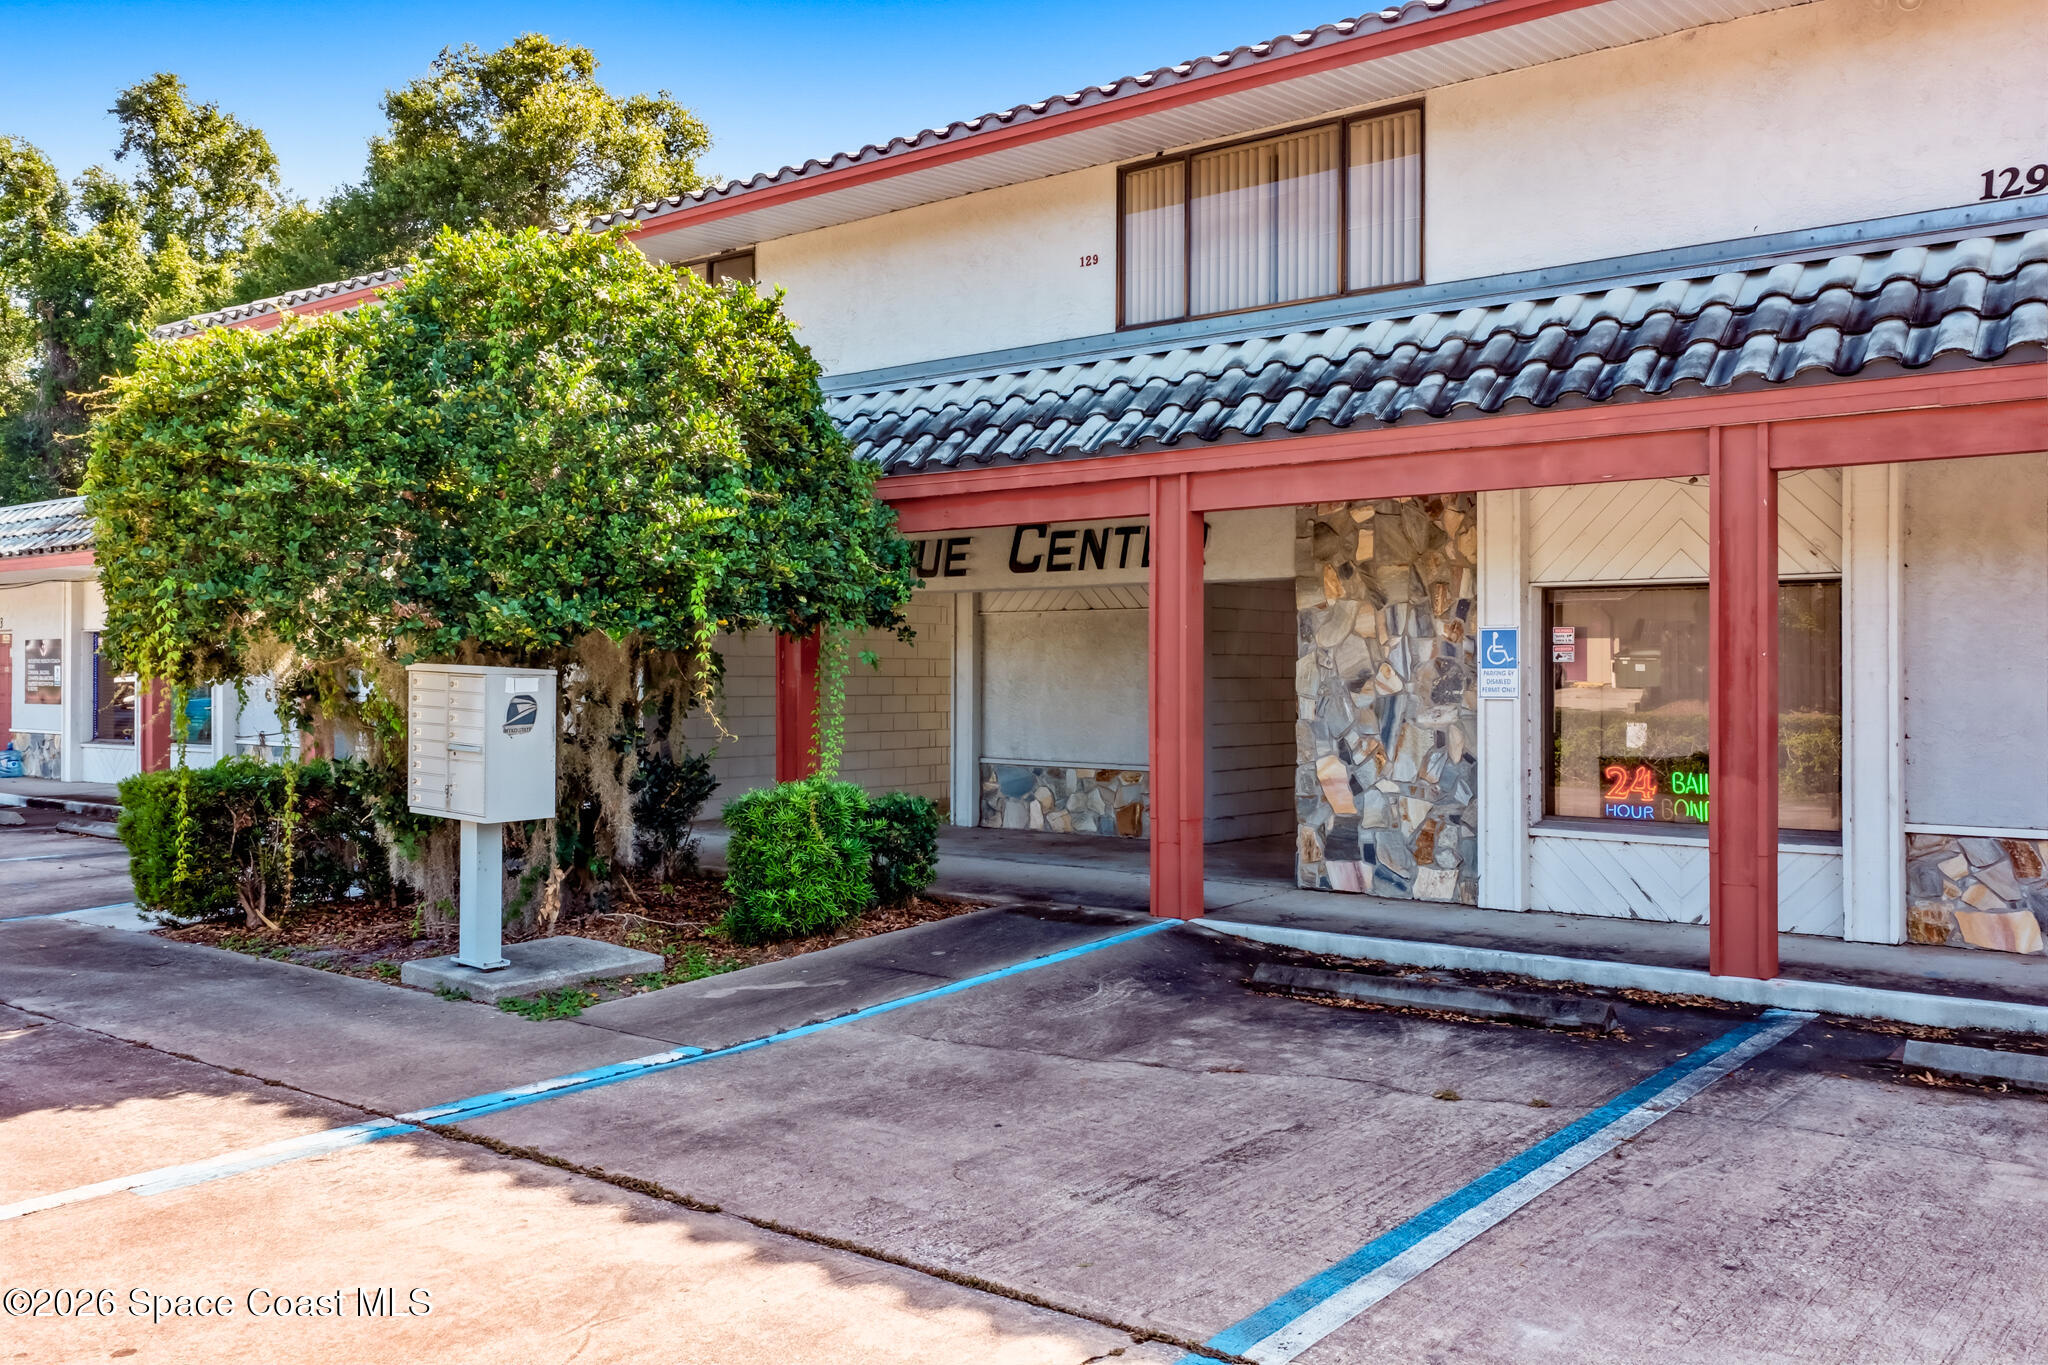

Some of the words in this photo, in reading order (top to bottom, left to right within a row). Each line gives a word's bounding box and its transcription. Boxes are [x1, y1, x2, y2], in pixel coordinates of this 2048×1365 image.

[1979, 163, 2048, 201] 129
[1079, 254, 1099, 267] 129
[916, 536, 972, 578] UE
[1009, 523, 1209, 574] CENT
[1604, 765, 1657, 802] 24
[1606, 803, 1655, 820] HOUR
